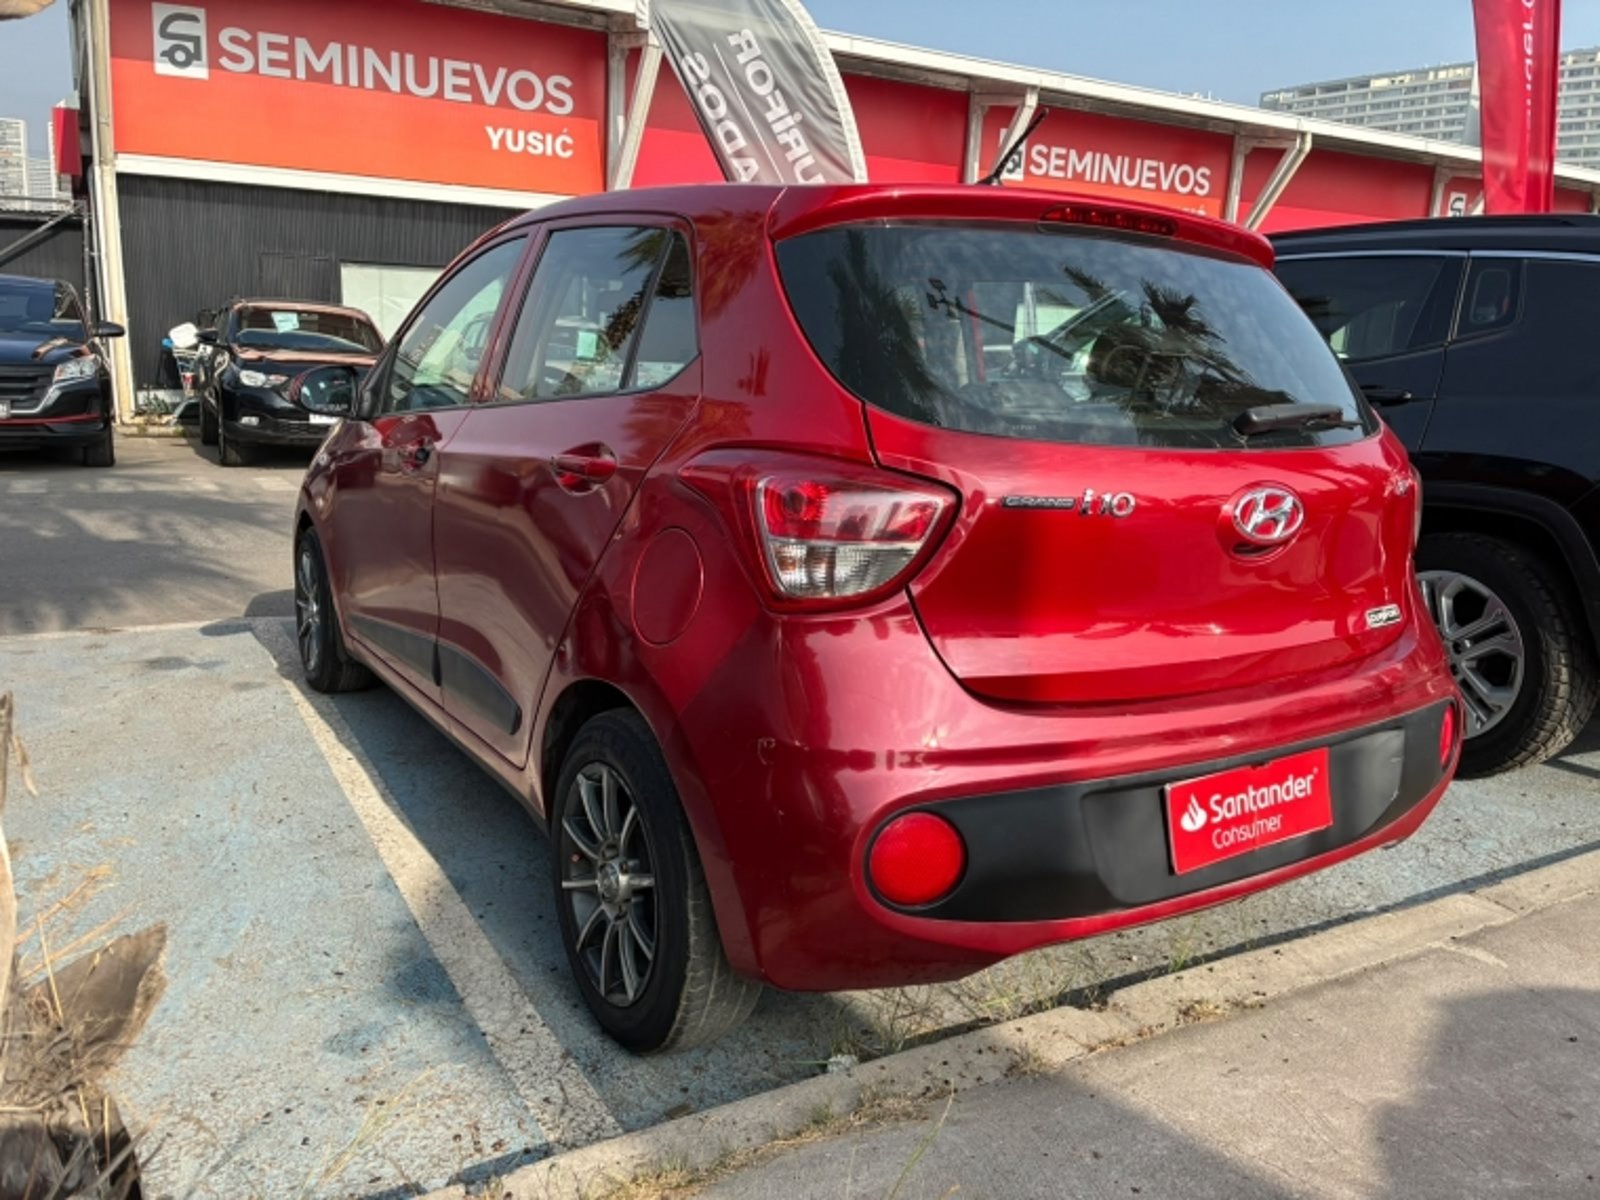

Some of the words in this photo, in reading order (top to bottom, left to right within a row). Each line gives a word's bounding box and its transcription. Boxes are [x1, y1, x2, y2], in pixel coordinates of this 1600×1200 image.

[218, 27, 574, 116] SEMINUEVOS
[485, 127, 574, 158] YUSIĆ
[1029, 144, 1211, 196] SEMINUEVOS
[1209, 774, 1314, 824] Santander
[1211, 814, 1283, 849] Consumer
